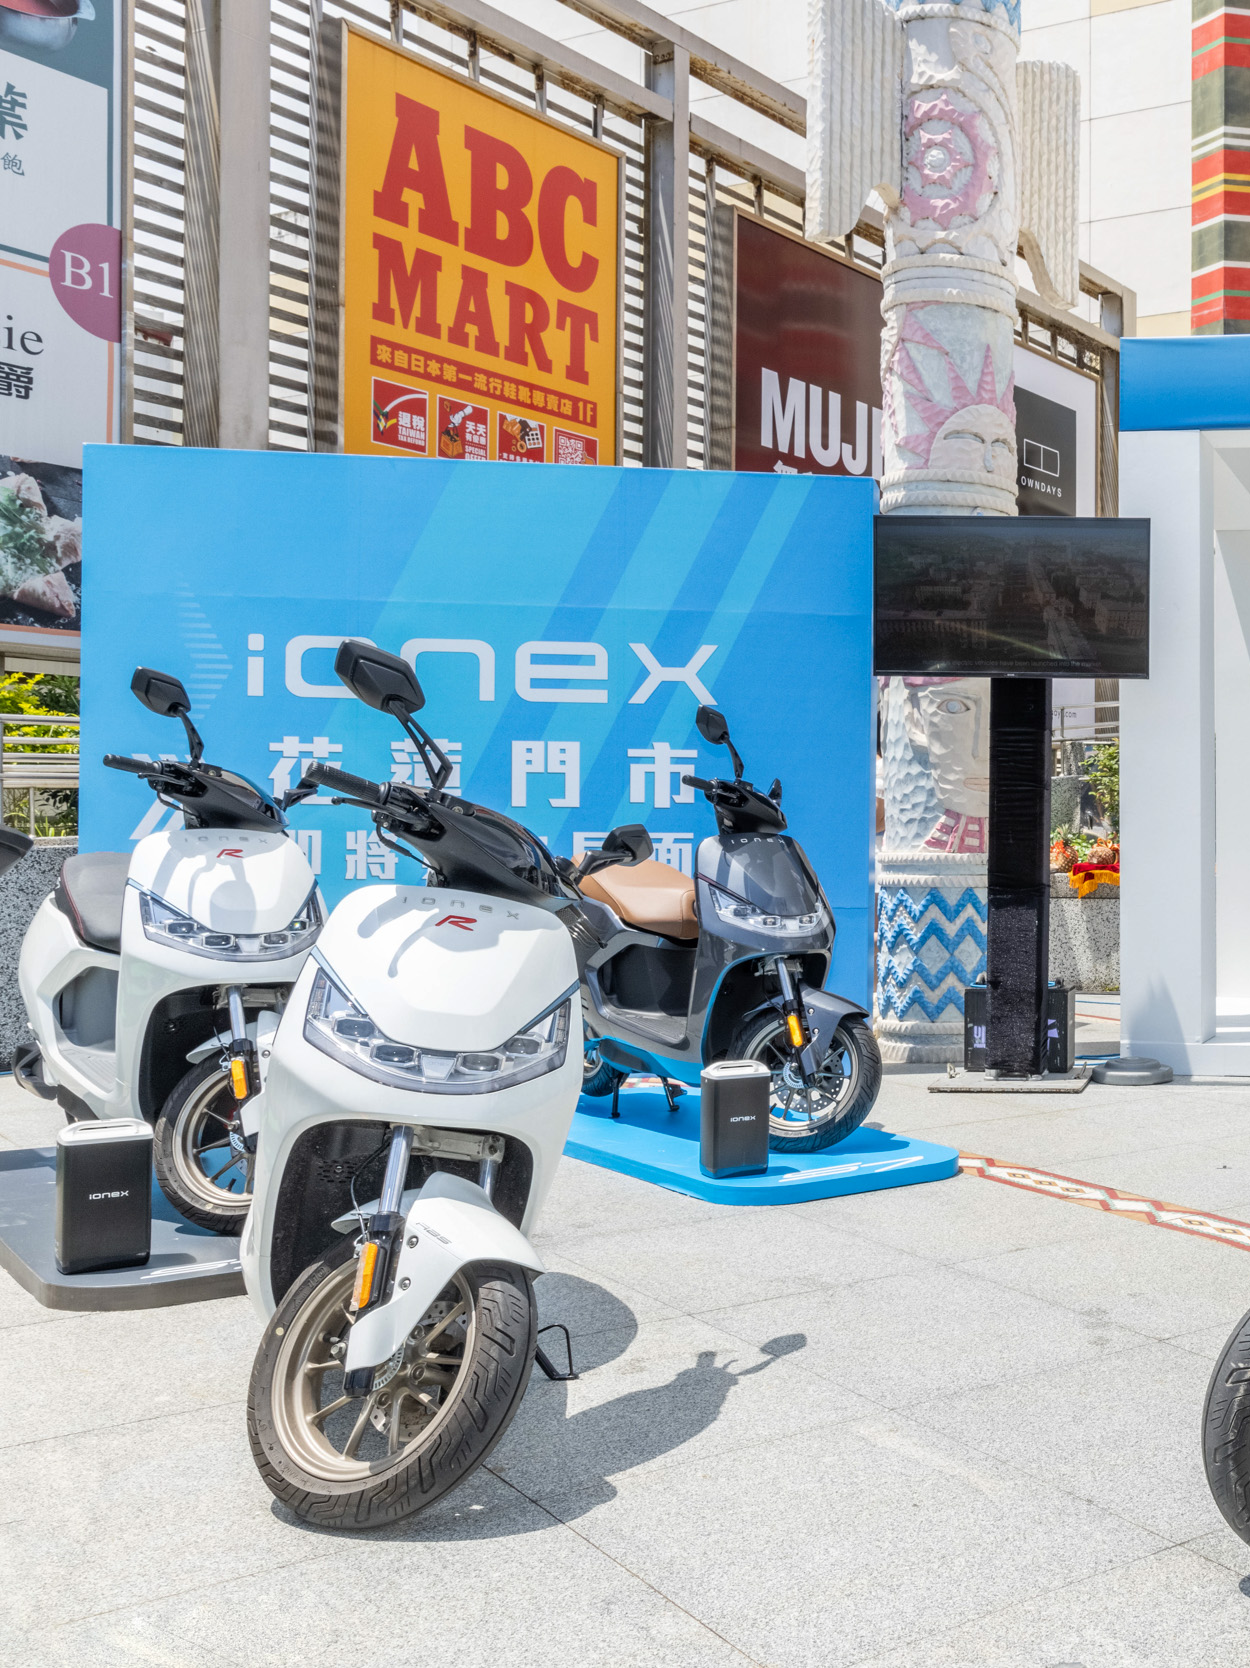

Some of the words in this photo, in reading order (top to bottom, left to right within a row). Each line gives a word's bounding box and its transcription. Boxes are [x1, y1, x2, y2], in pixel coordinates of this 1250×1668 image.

[373, 92, 599, 294] ABC
[60, 249, 114, 298] B1
[372, 232, 599, 386] MART
[578, 401, 595, 424] 1F
[398, 426, 425, 440] TAIWAN
[465, 420, 487, 437] 天天
[1020, 476, 1062, 498] OWNDAYS
[184, 835, 268, 844] ionex
[402, 896, 519, 920] ionex
[89, 1190, 129, 1200] ionex
